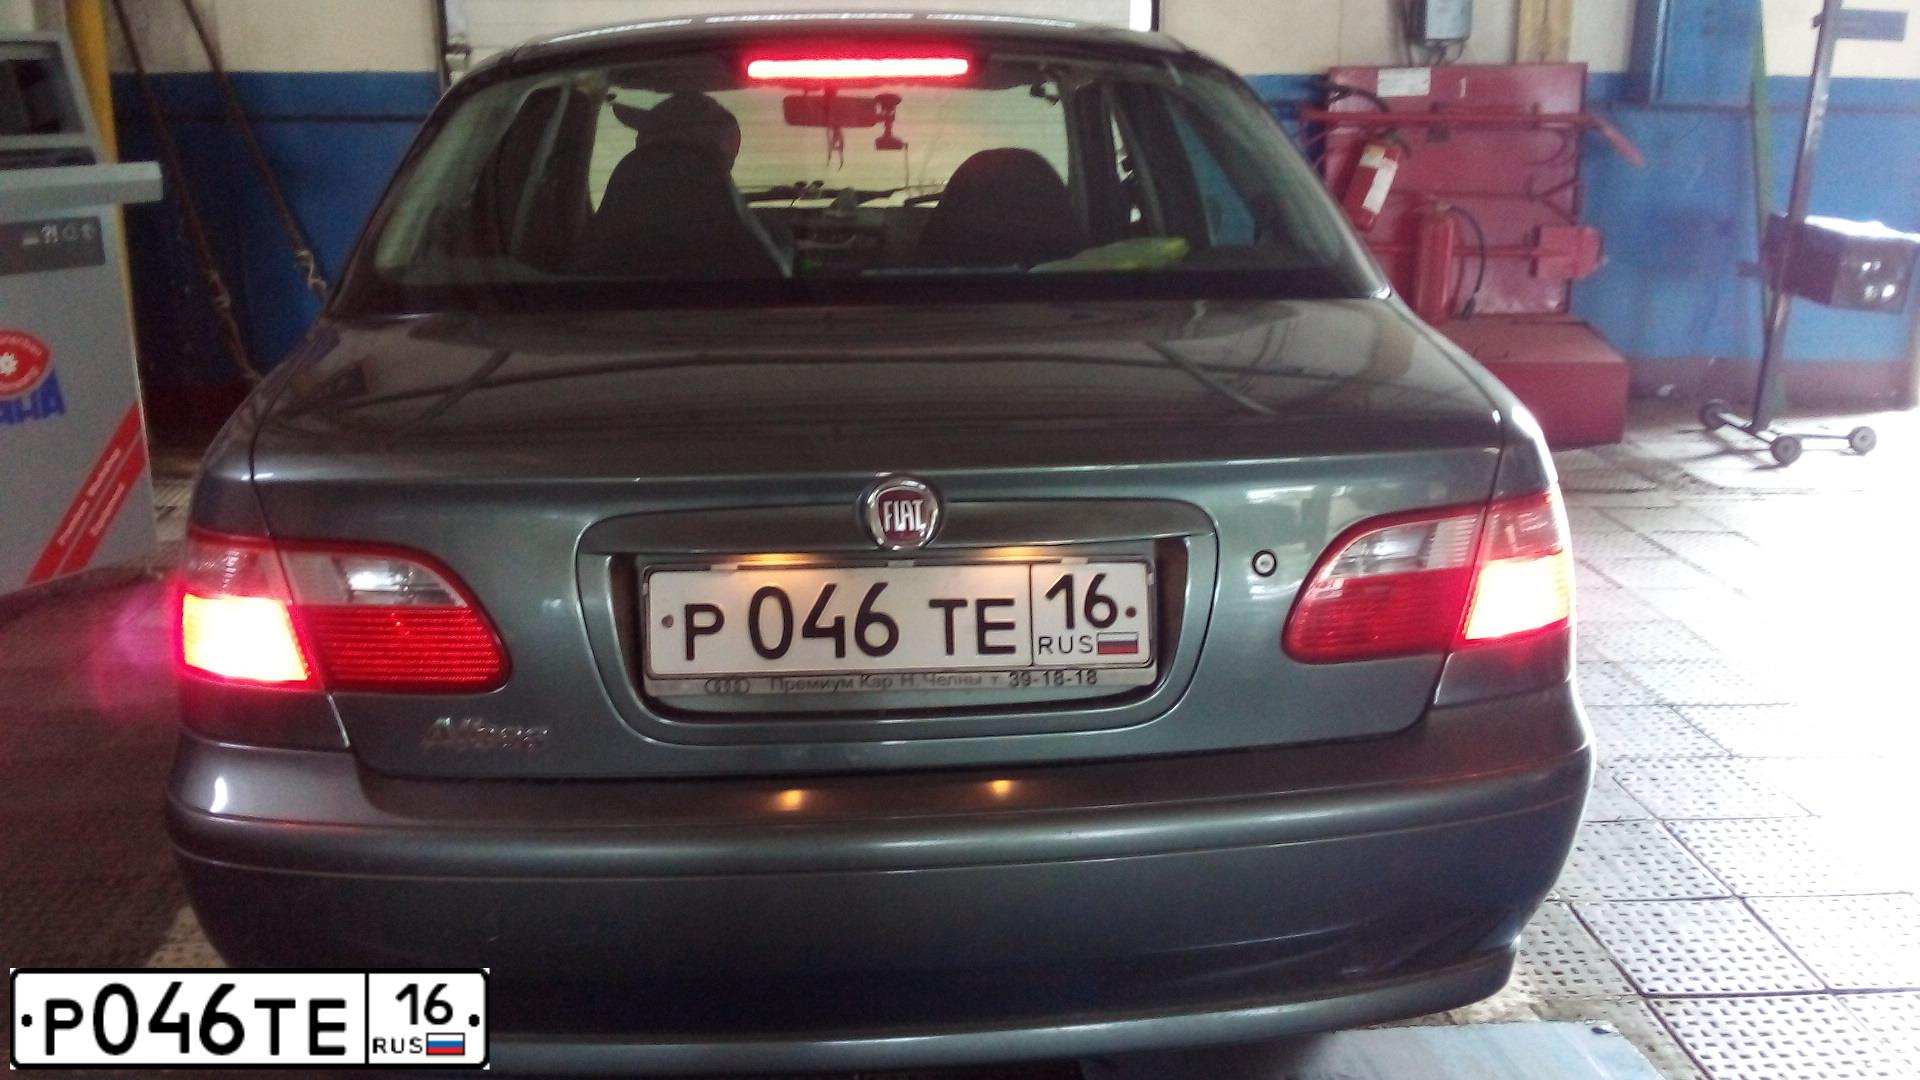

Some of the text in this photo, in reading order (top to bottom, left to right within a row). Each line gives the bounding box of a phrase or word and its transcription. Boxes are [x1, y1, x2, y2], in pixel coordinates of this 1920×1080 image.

[883, 500, 926, 532] FIAT
[1045, 573, 1119, 630] 16
[747, 581, 900, 661] 046
[1038, 635, 1094, 655] RUS
[1008, 669, 1098, 687] 39-18-18
